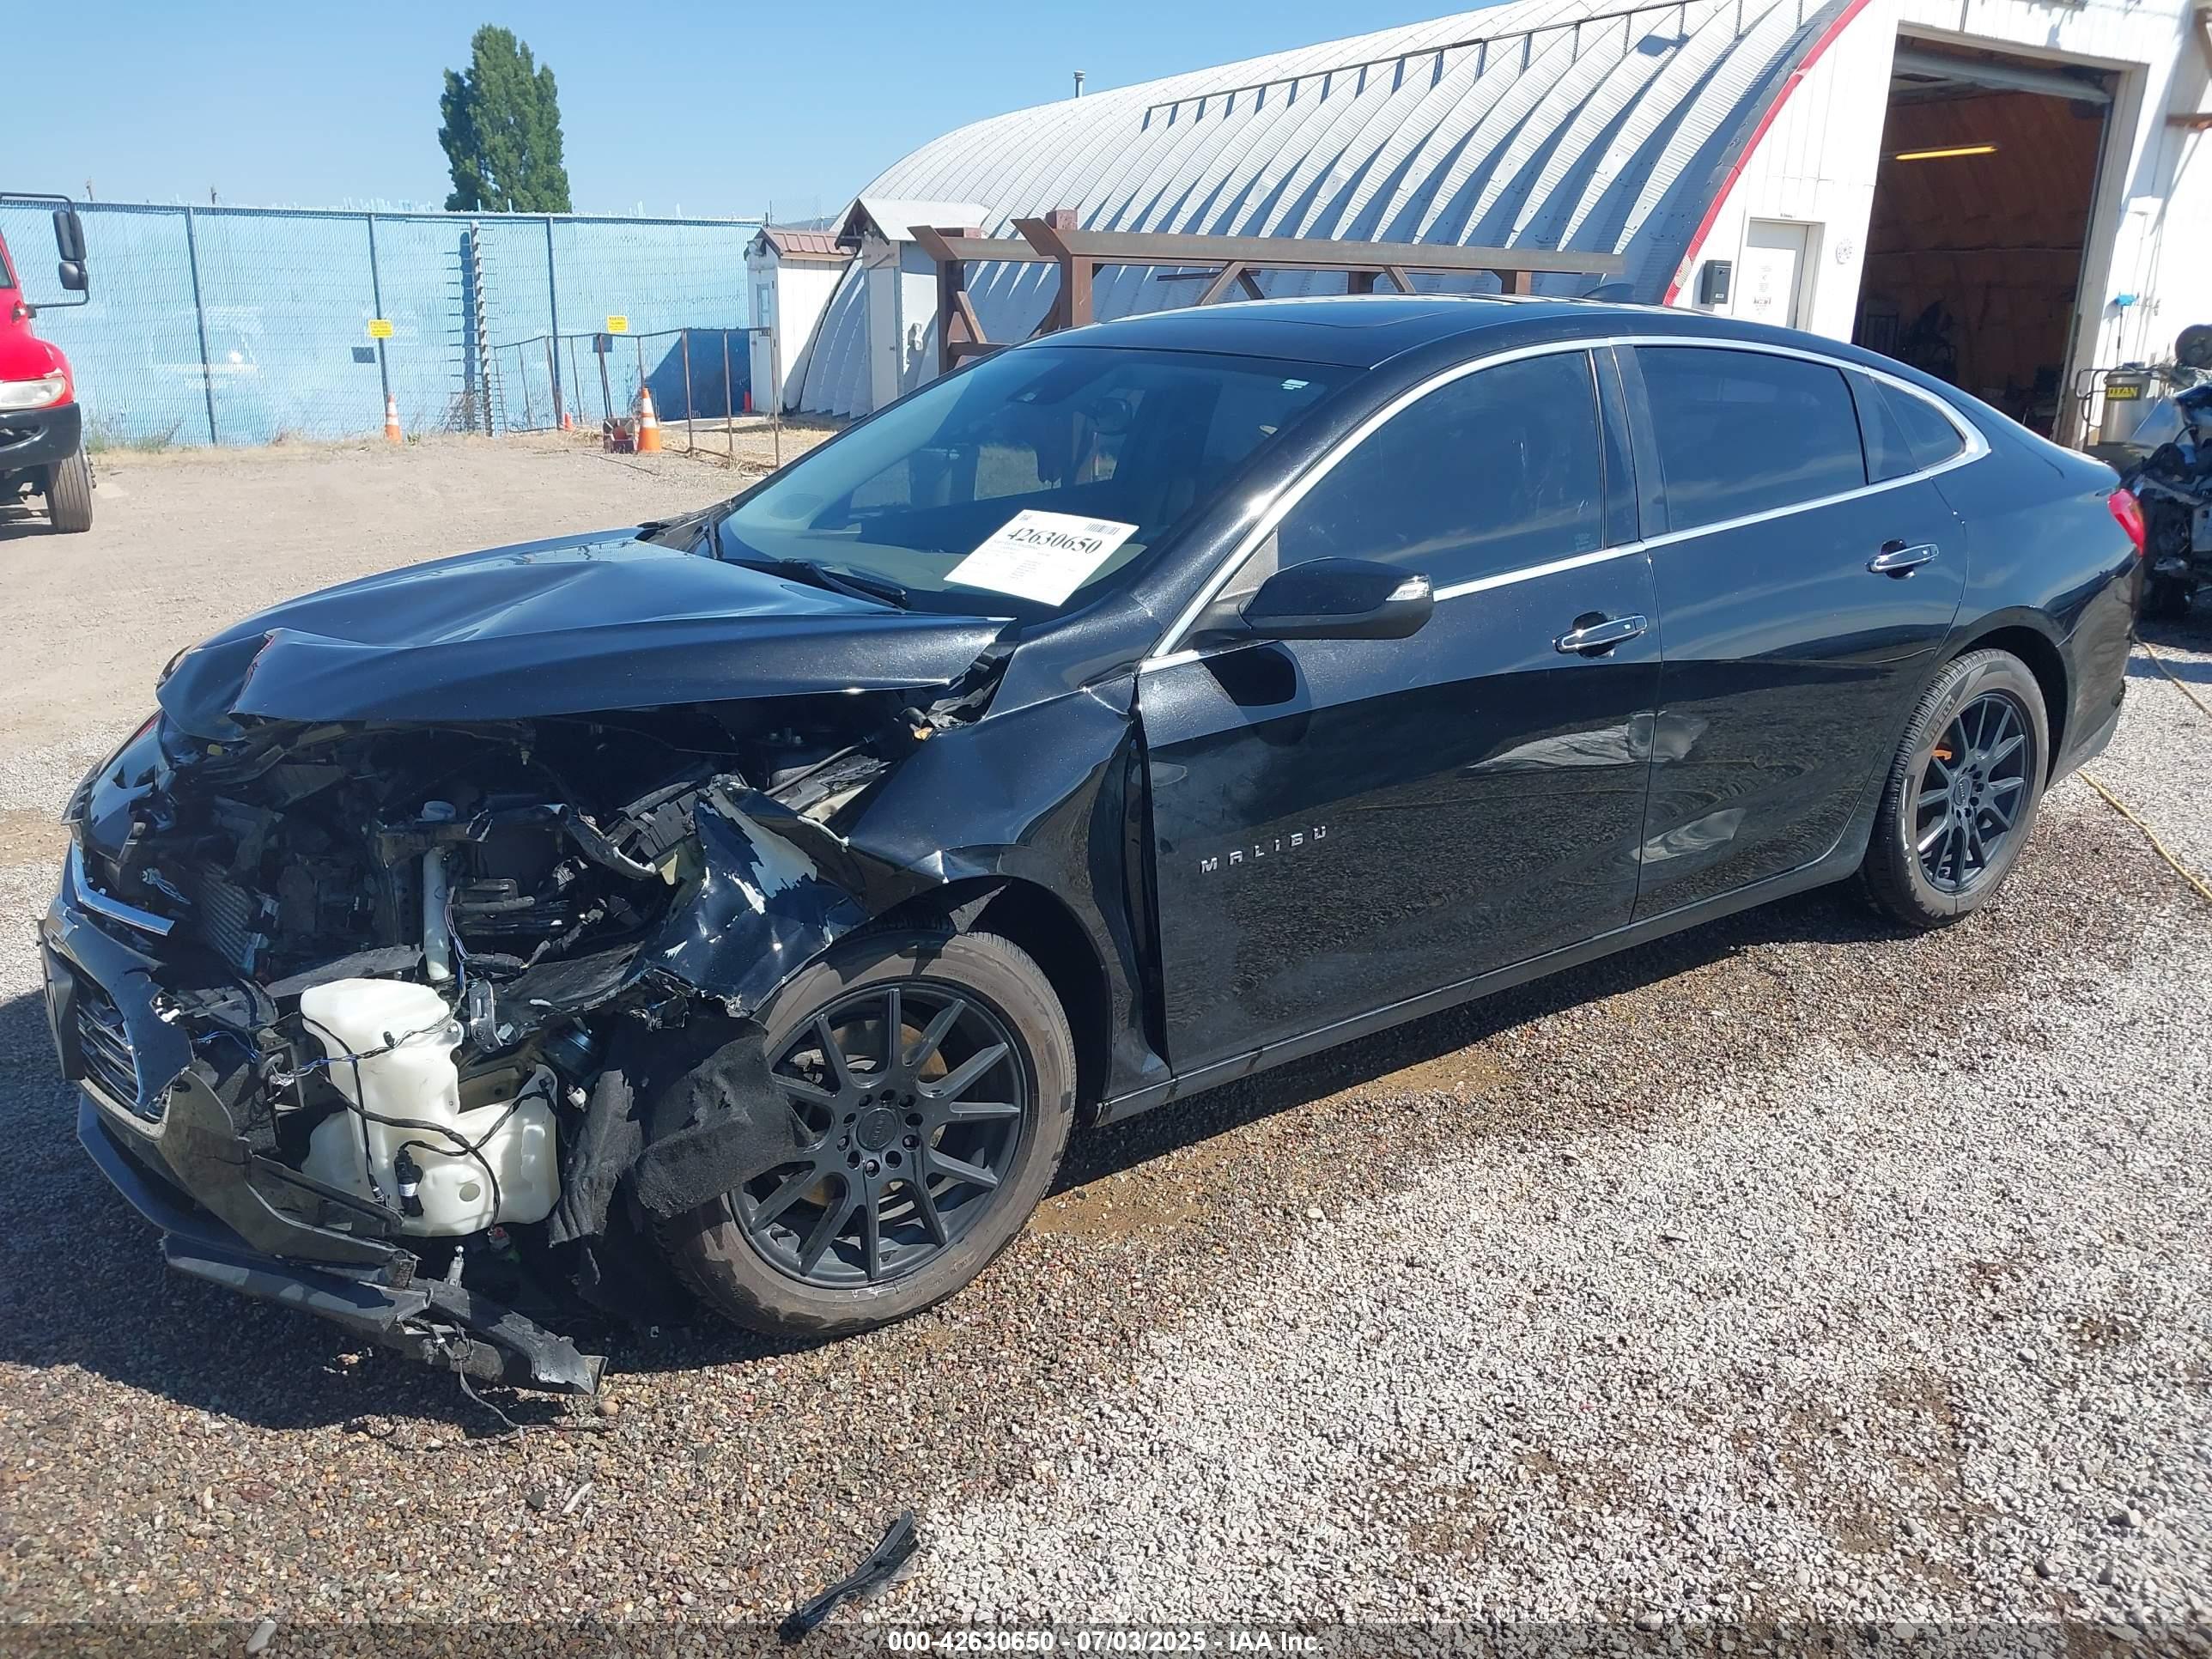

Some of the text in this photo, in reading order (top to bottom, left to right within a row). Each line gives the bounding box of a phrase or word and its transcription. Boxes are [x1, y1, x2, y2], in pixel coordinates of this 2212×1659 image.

[2107, 386, 2138, 397] TITAN
[1007, 527, 1103, 555] 42630650
[1200, 825, 1326, 874] MALIBU
